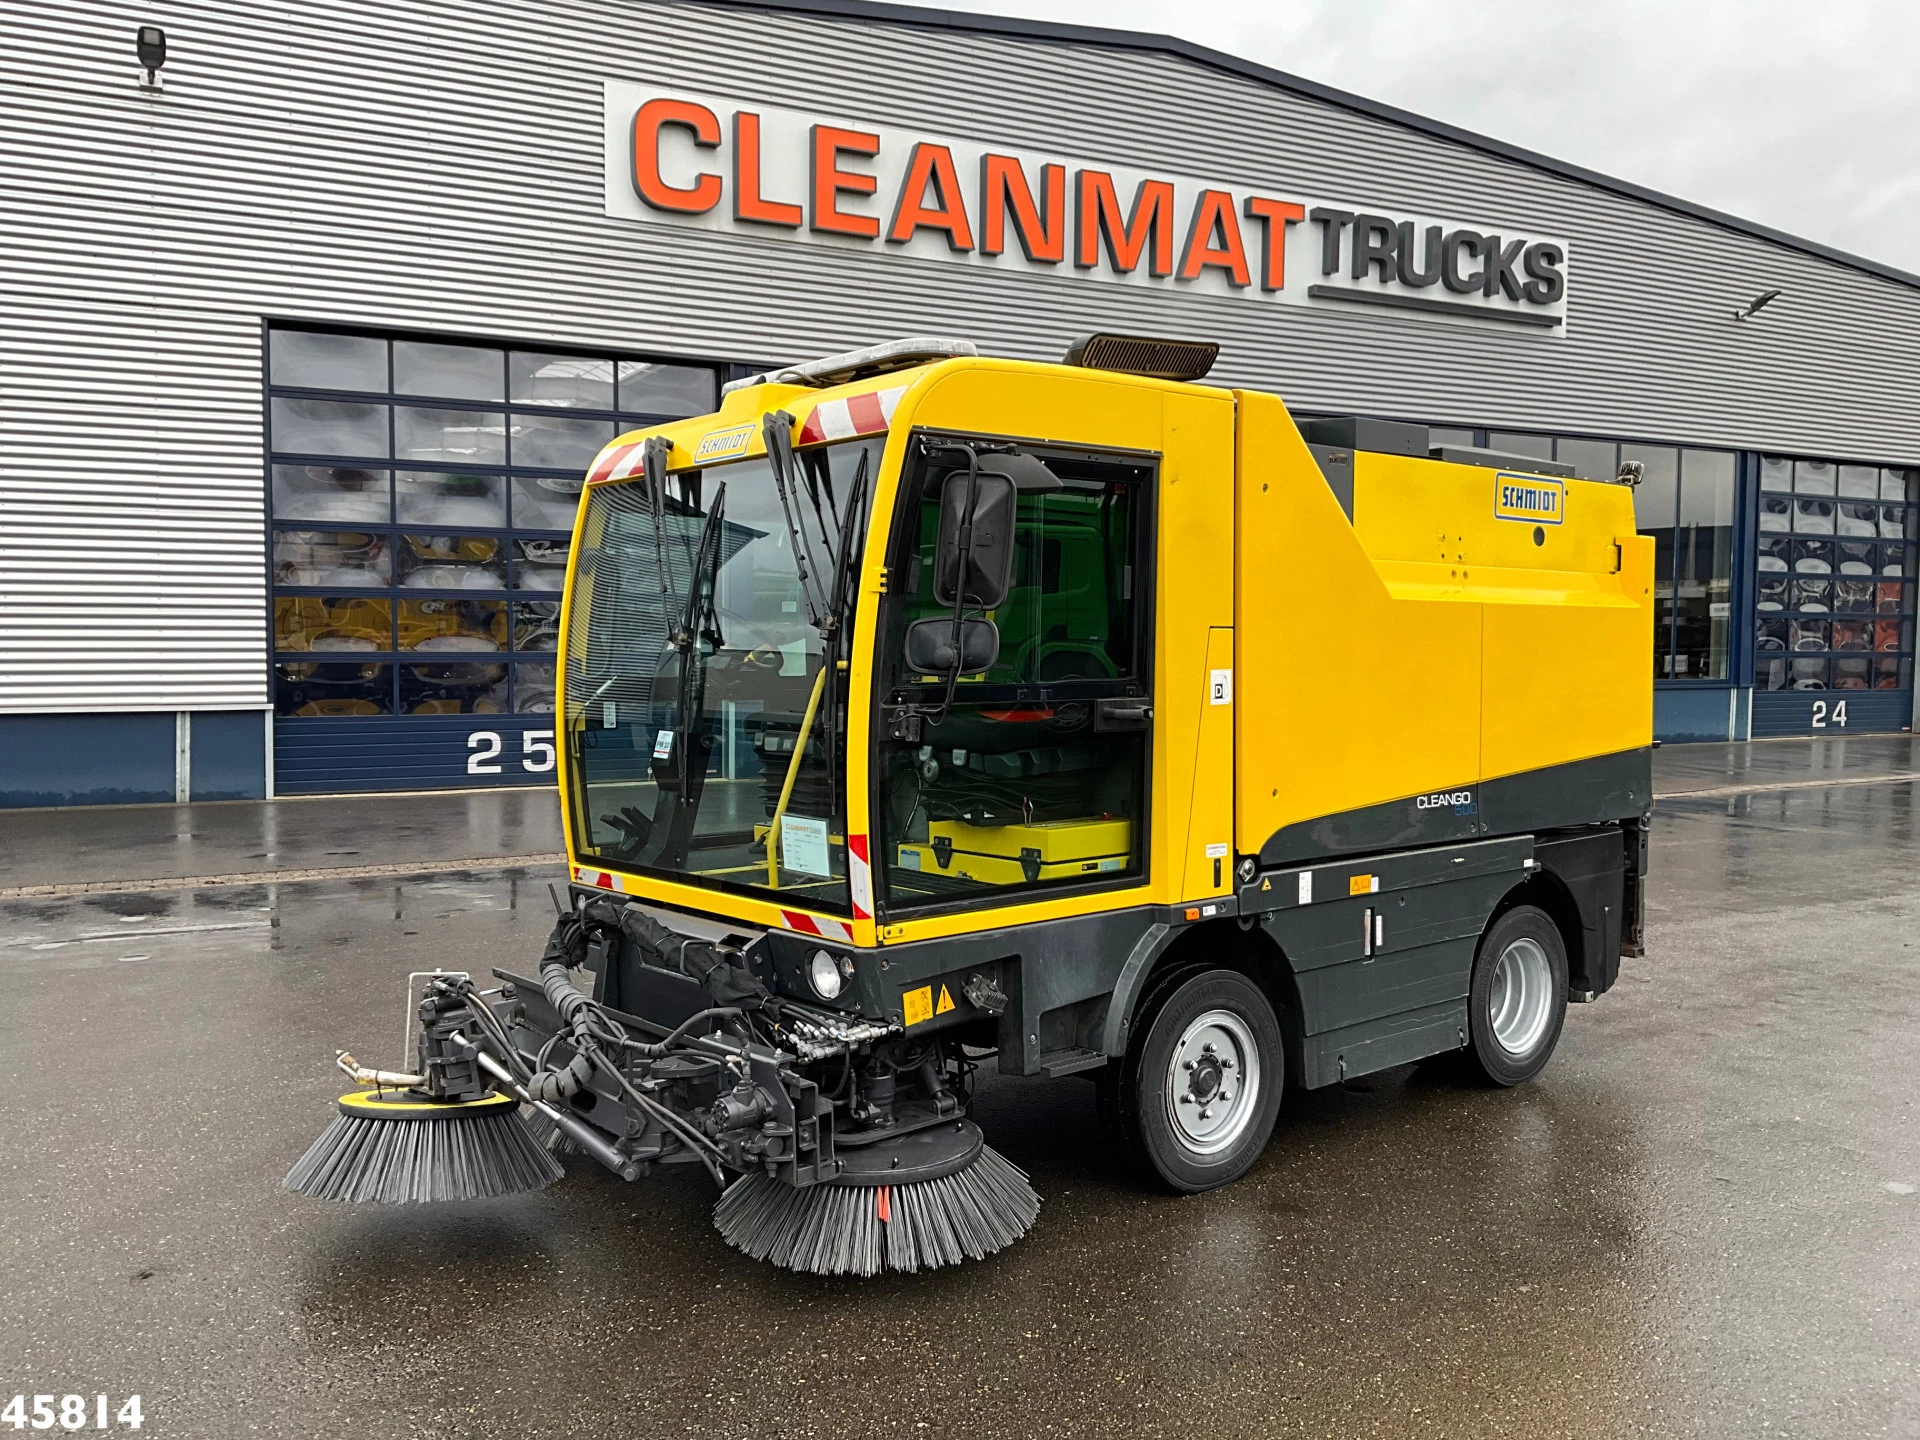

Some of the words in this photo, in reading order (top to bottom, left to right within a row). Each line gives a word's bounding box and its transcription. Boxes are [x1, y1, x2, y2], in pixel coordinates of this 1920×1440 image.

[630, 97, 1305, 292] CLEANMAT
[1309, 206, 1564, 305] TRUCKS
[700, 432, 747, 453] SCHMIDT
[1502, 485, 1557, 512] SCHMIDT
[1811, 700, 1848, 728] 24
[467, 730, 556, 774] 25
[1417, 791, 1471, 809] CLEANGO
[1455, 803, 1478, 816] 500
